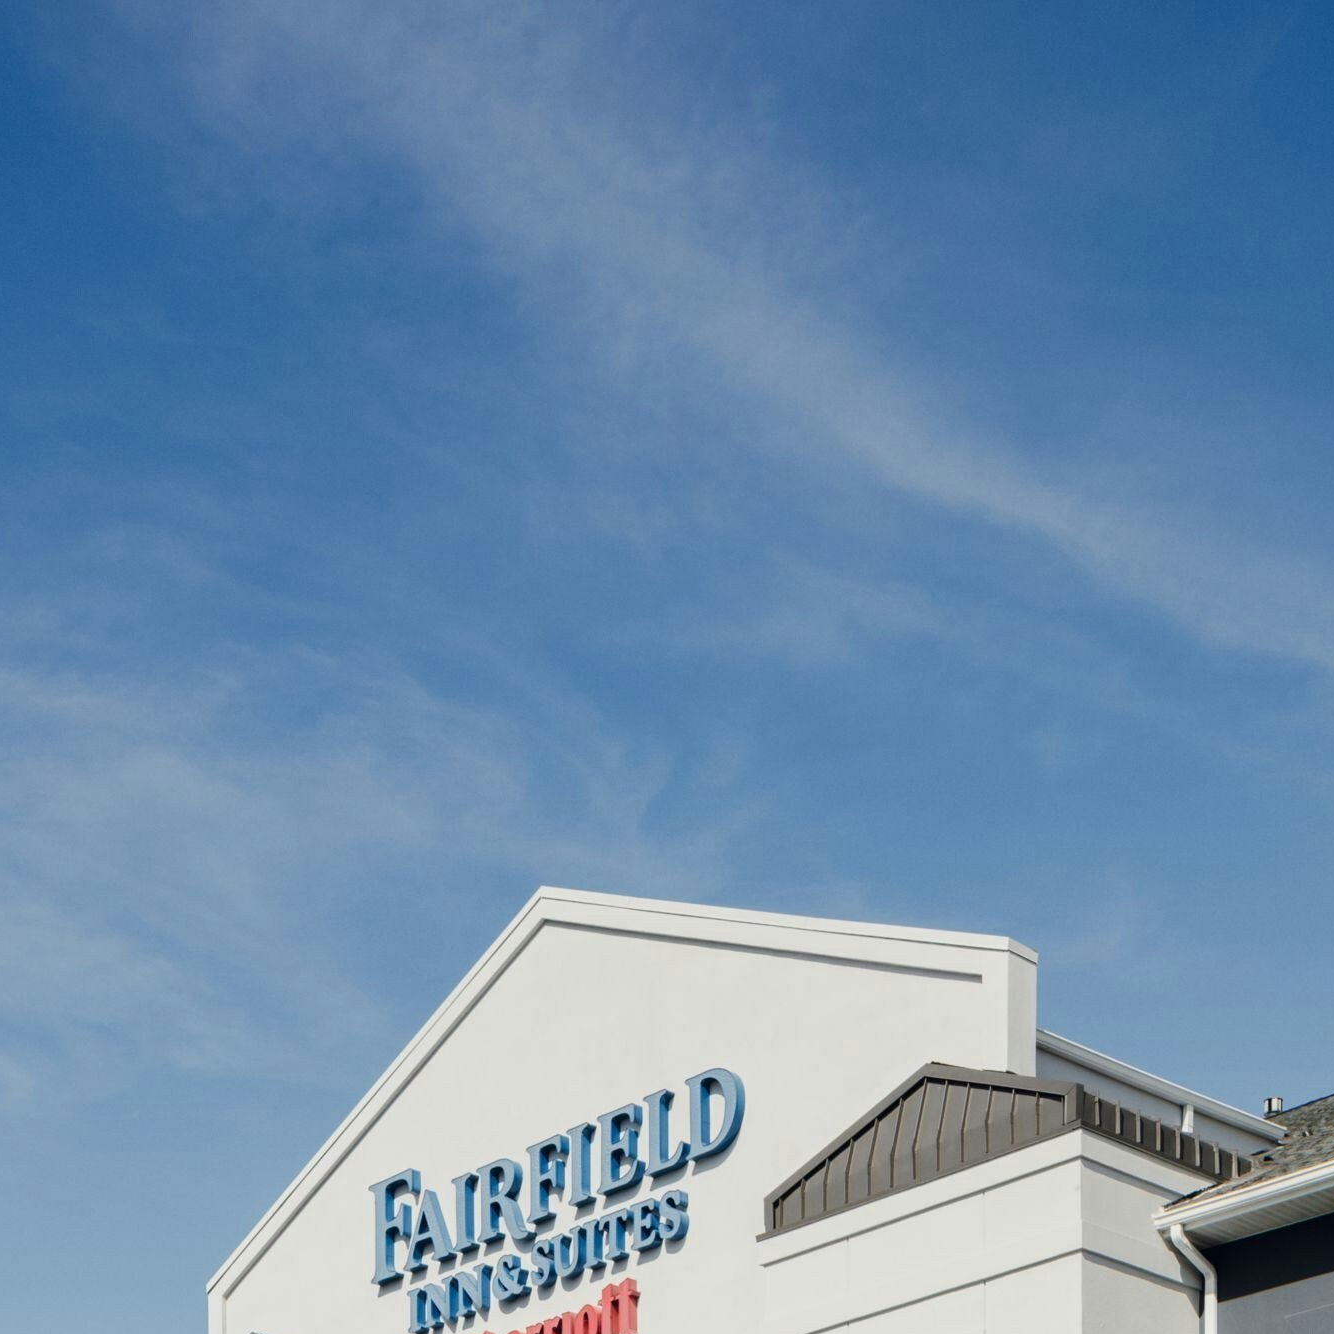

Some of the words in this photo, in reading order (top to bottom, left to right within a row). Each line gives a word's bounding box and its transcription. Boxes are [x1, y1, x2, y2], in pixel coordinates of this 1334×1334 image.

[369, 1067, 746, 1286] FAIRFIELD
[408, 1263, 493, 1334] INN
[531, 1189, 689, 1287] SUITES
